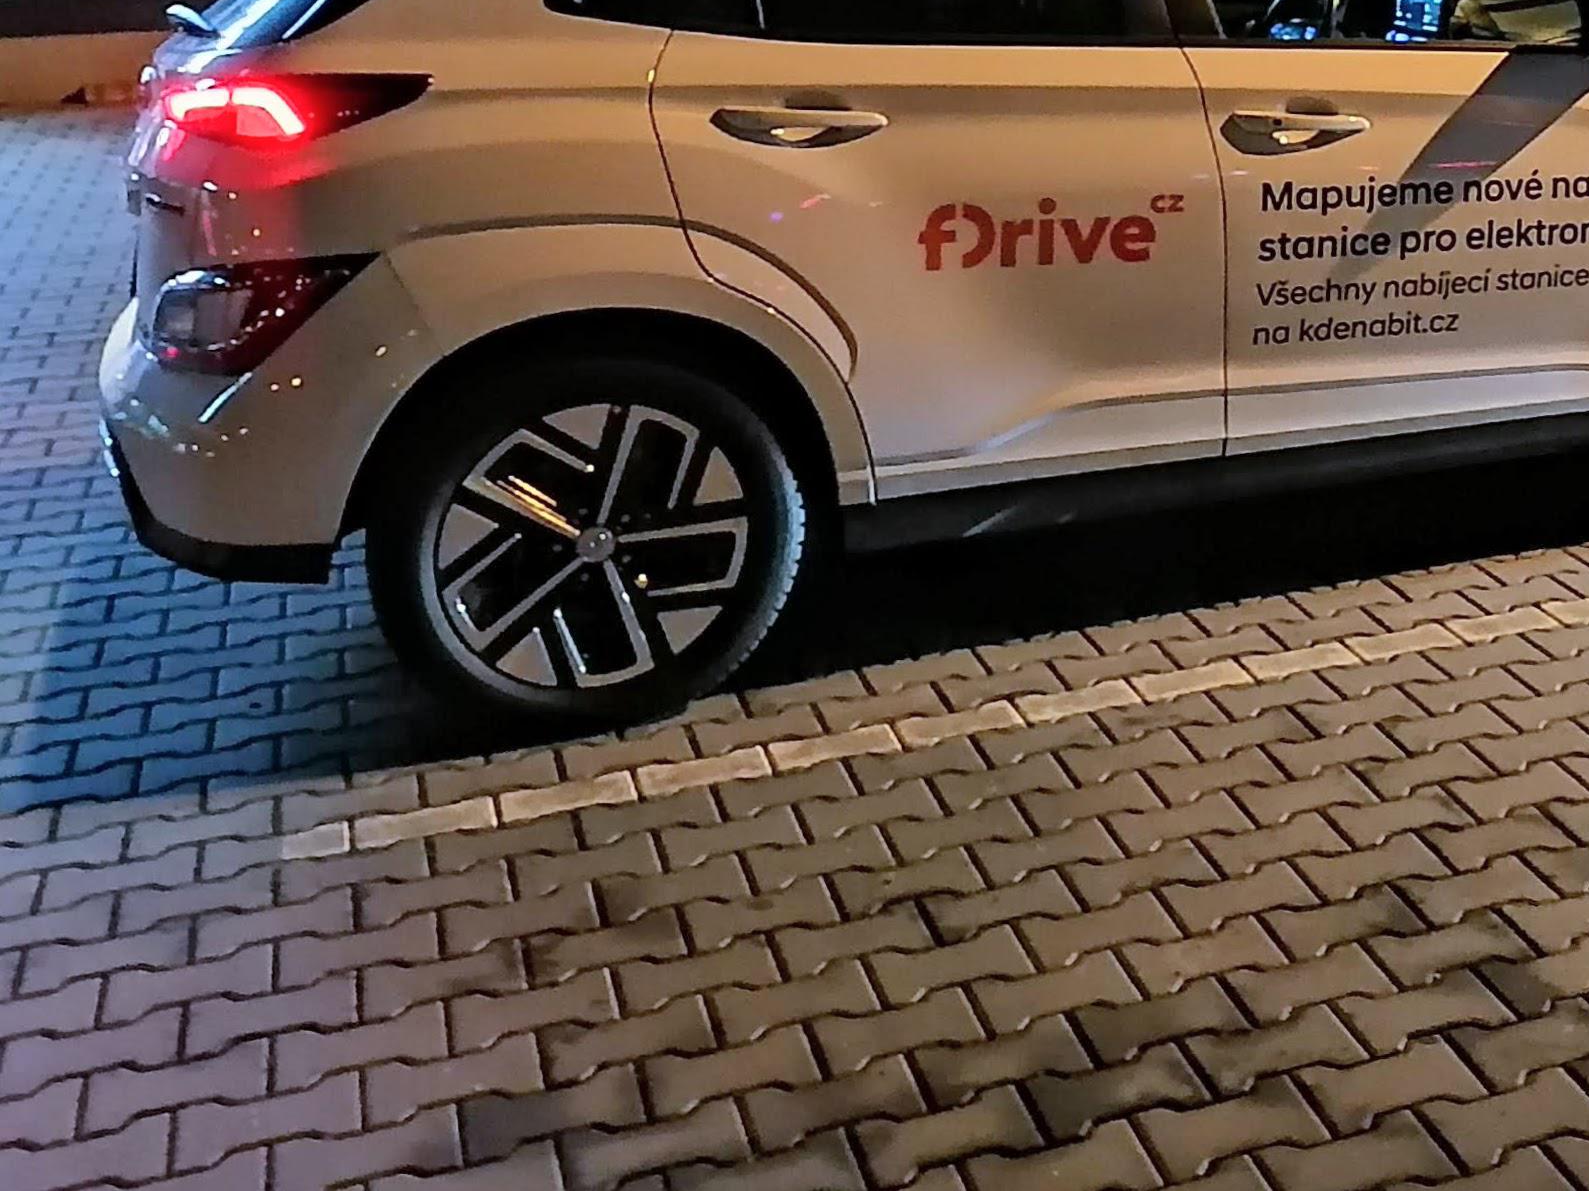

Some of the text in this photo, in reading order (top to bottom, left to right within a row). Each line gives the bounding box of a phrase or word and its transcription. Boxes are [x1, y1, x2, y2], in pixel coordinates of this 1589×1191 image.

[1261, 176, 1455, 216] Mapujeme
[1462, 169, 1544, 204] nové
[1257, 226, 1391, 263] stanice
[1399, 226, 1457, 261] pro
[1255, 278, 1377, 307] Všechny
[1383, 266, 1491, 301] nabíjecí
[1252, 311, 1460, 346] na kdenabit.cz
